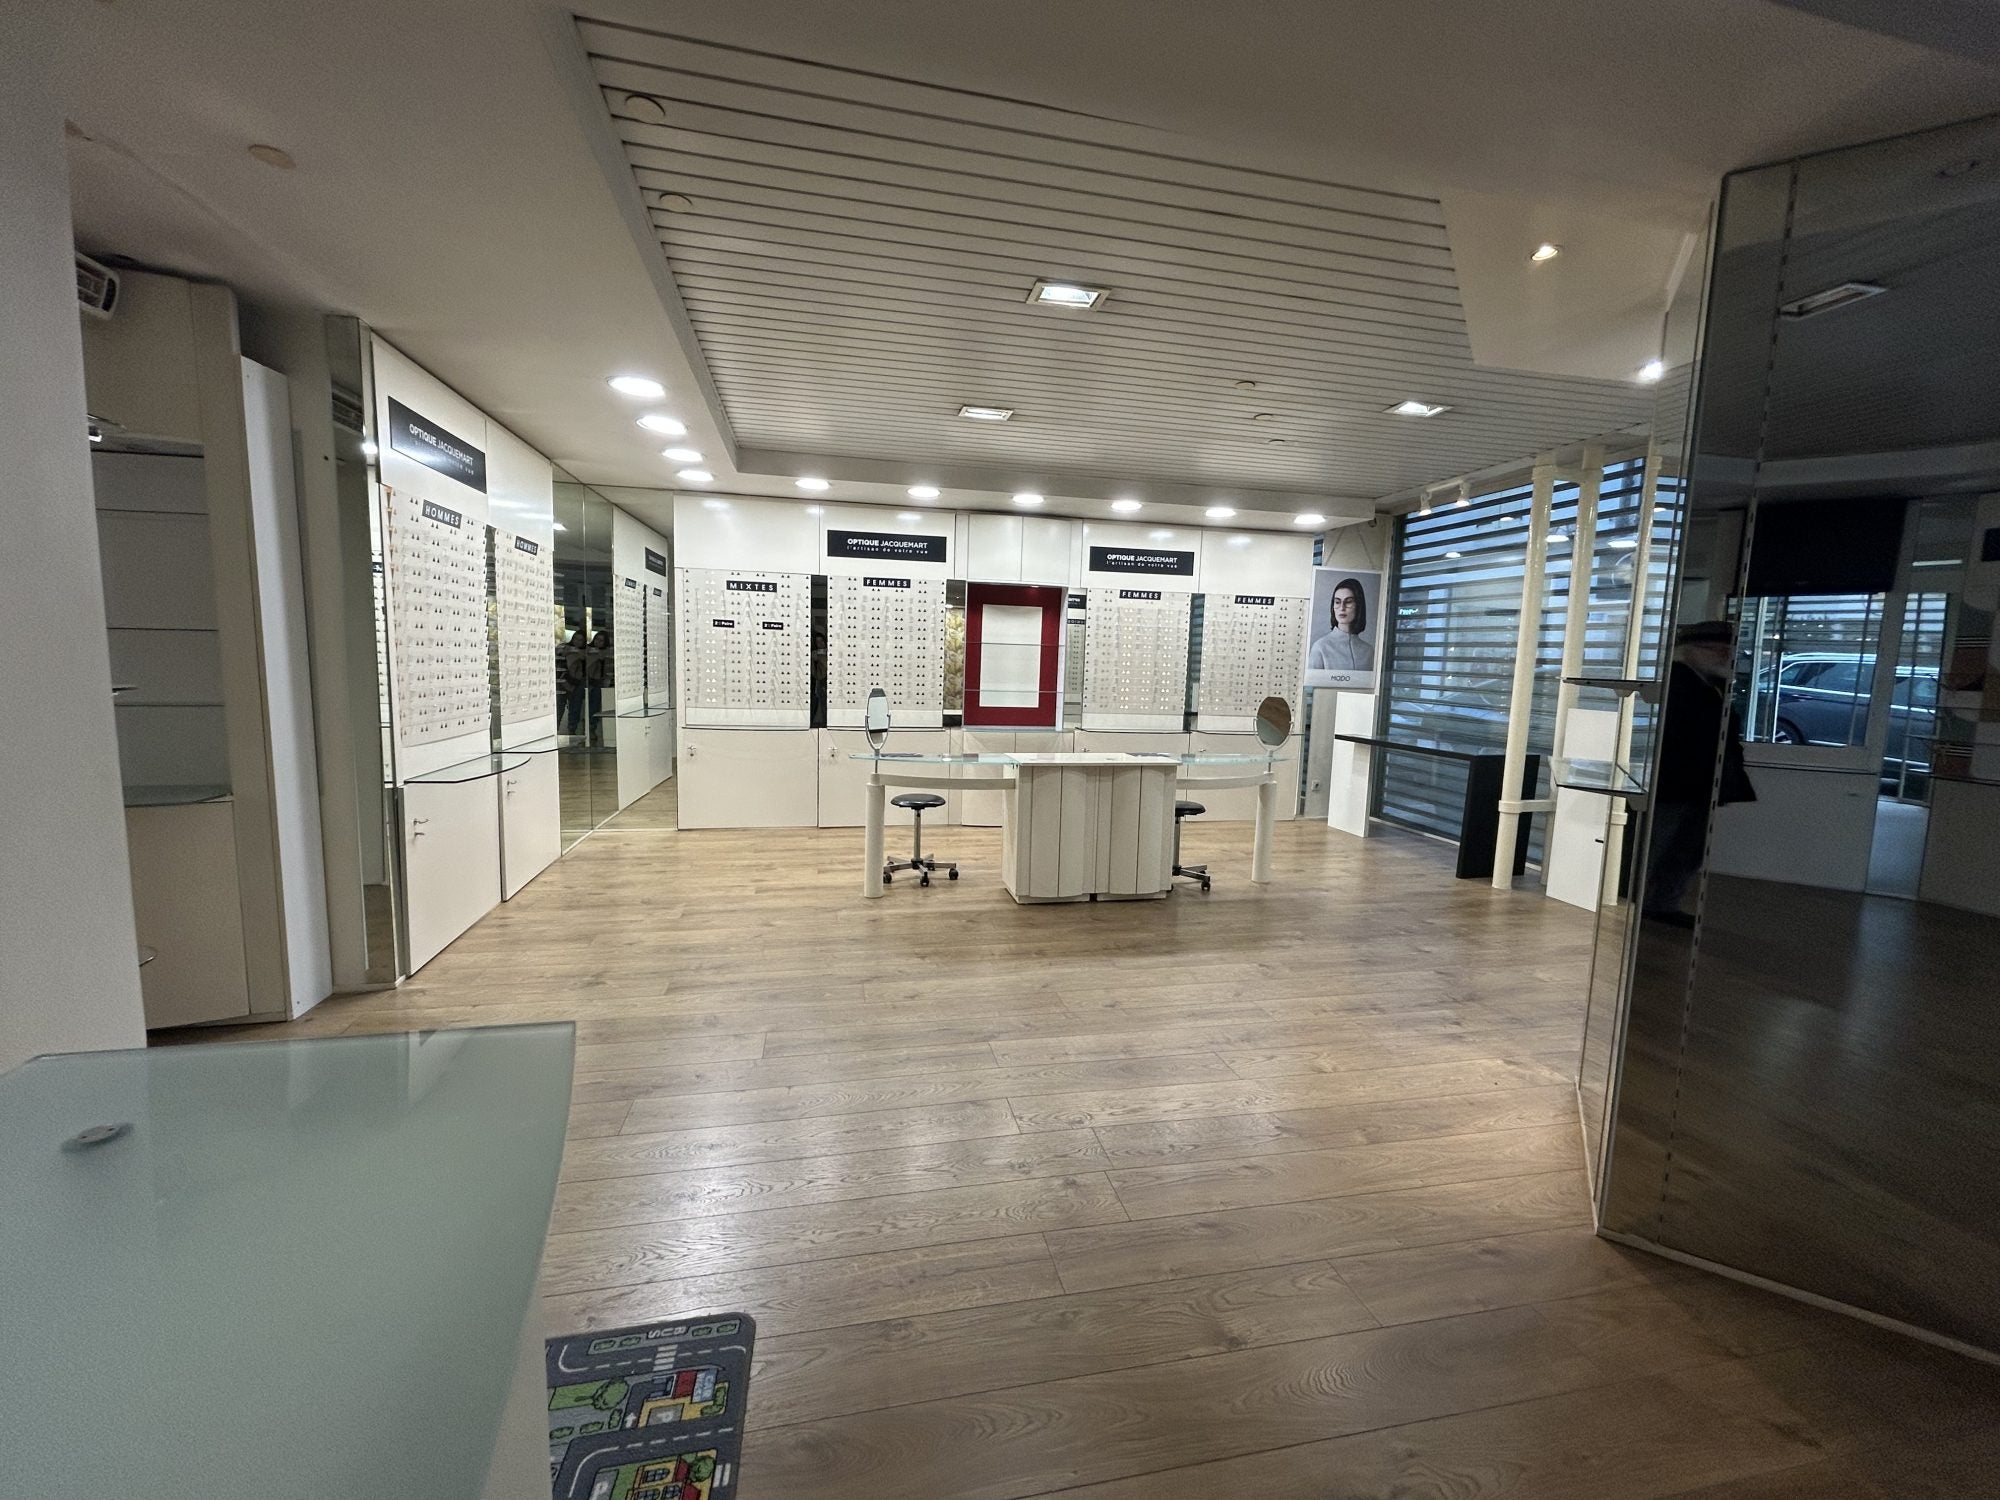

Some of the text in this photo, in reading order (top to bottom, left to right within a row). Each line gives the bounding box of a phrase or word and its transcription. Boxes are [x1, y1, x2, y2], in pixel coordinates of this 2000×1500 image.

[409, 423, 437, 446] OPTIQUE
[437, 440, 473, 466] JACQUEMART
[425, 505, 460, 526] HOMMES
[516, 539, 537, 554] HOMMES
[847, 538, 928, 549] OPTIQUE JACQUEMART
[1106, 554, 1178, 564] OPTIQUE JACQUEMART
[729, 582, 774, 592] MIXTES
[866, 578, 908, 588] FEMMES
[1121, 591, 1159, 600] FEMMES
[1237, 597, 1272, 605] FEMMES
[648, 1326, 687, 1339] BUS
